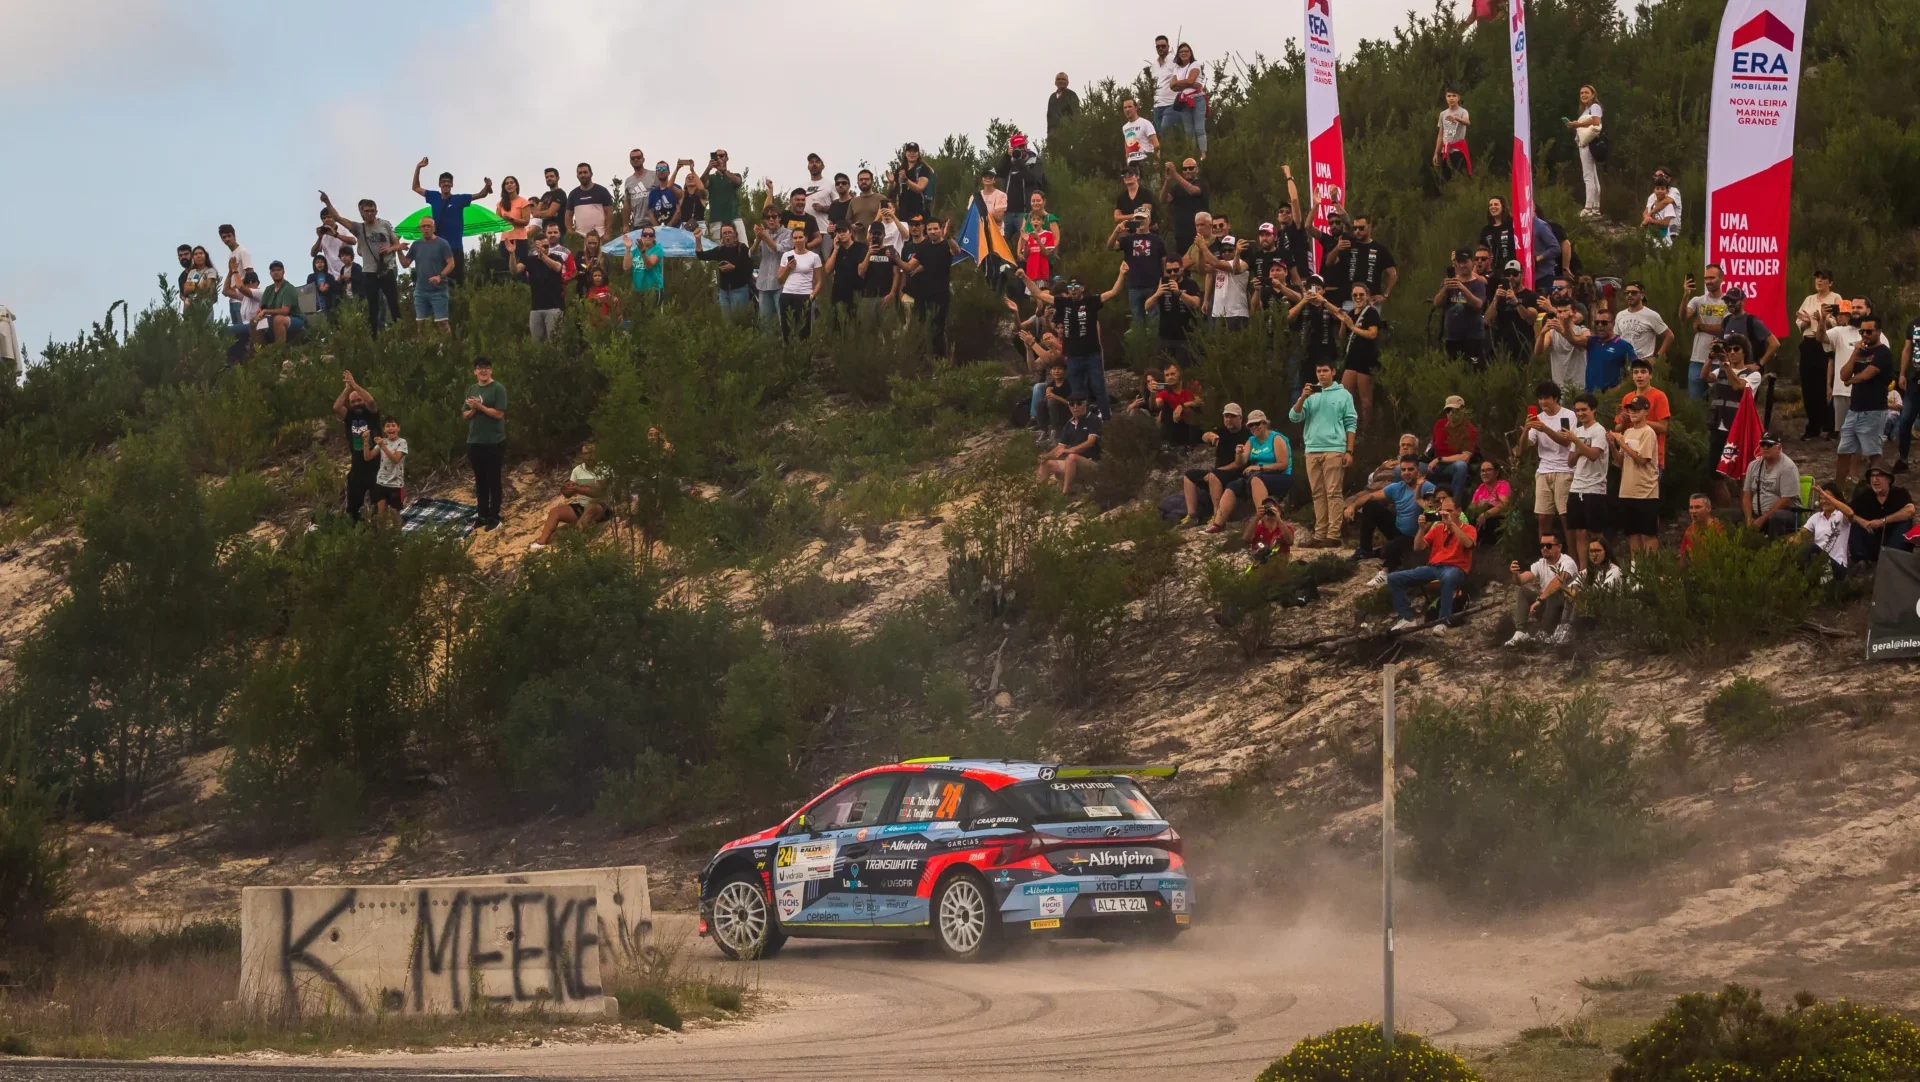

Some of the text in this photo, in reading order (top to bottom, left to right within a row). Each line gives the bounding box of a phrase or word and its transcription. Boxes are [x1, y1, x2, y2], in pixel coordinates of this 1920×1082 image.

[1732, 52, 1788, 74] ERA
[1730, 83, 1788, 91] IMOBILIÁRIA
[1729, 98, 1756, 106] NOVA
[1736, 109, 1780, 117] MARINHA
[1738, 118, 1778, 126] GRANDE
[1315, 162, 1332, 179] UMA
[1318, 204, 1324, 219] A
[1720, 213, 1748, 230] UMA
[1720, 233, 1778, 253] MÁQUINA
[1720, 258, 1780, 276] A VENDER
[935, 783, 964, 819] 24
[976, 816, 1019, 825] CRAIG BREEN
[1067, 823, 1154, 833] cetelem cetelem
[889, 839, 927, 852] Albufeira
[947, 839, 979, 847] GARCIAS
[778, 847, 792, 867] 24
[1089, 851, 1154, 868] Albufeira
[1096, 876, 1144, 891] xtraFLEX
[1025, 886, 1055, 895] Alberto
[779, 899, 799, 907] FUCHS
[1120, 899, 1127, 911] R
[1129, 899, 1146, 911] 224
[807, 910, 840, 921] cetelem
